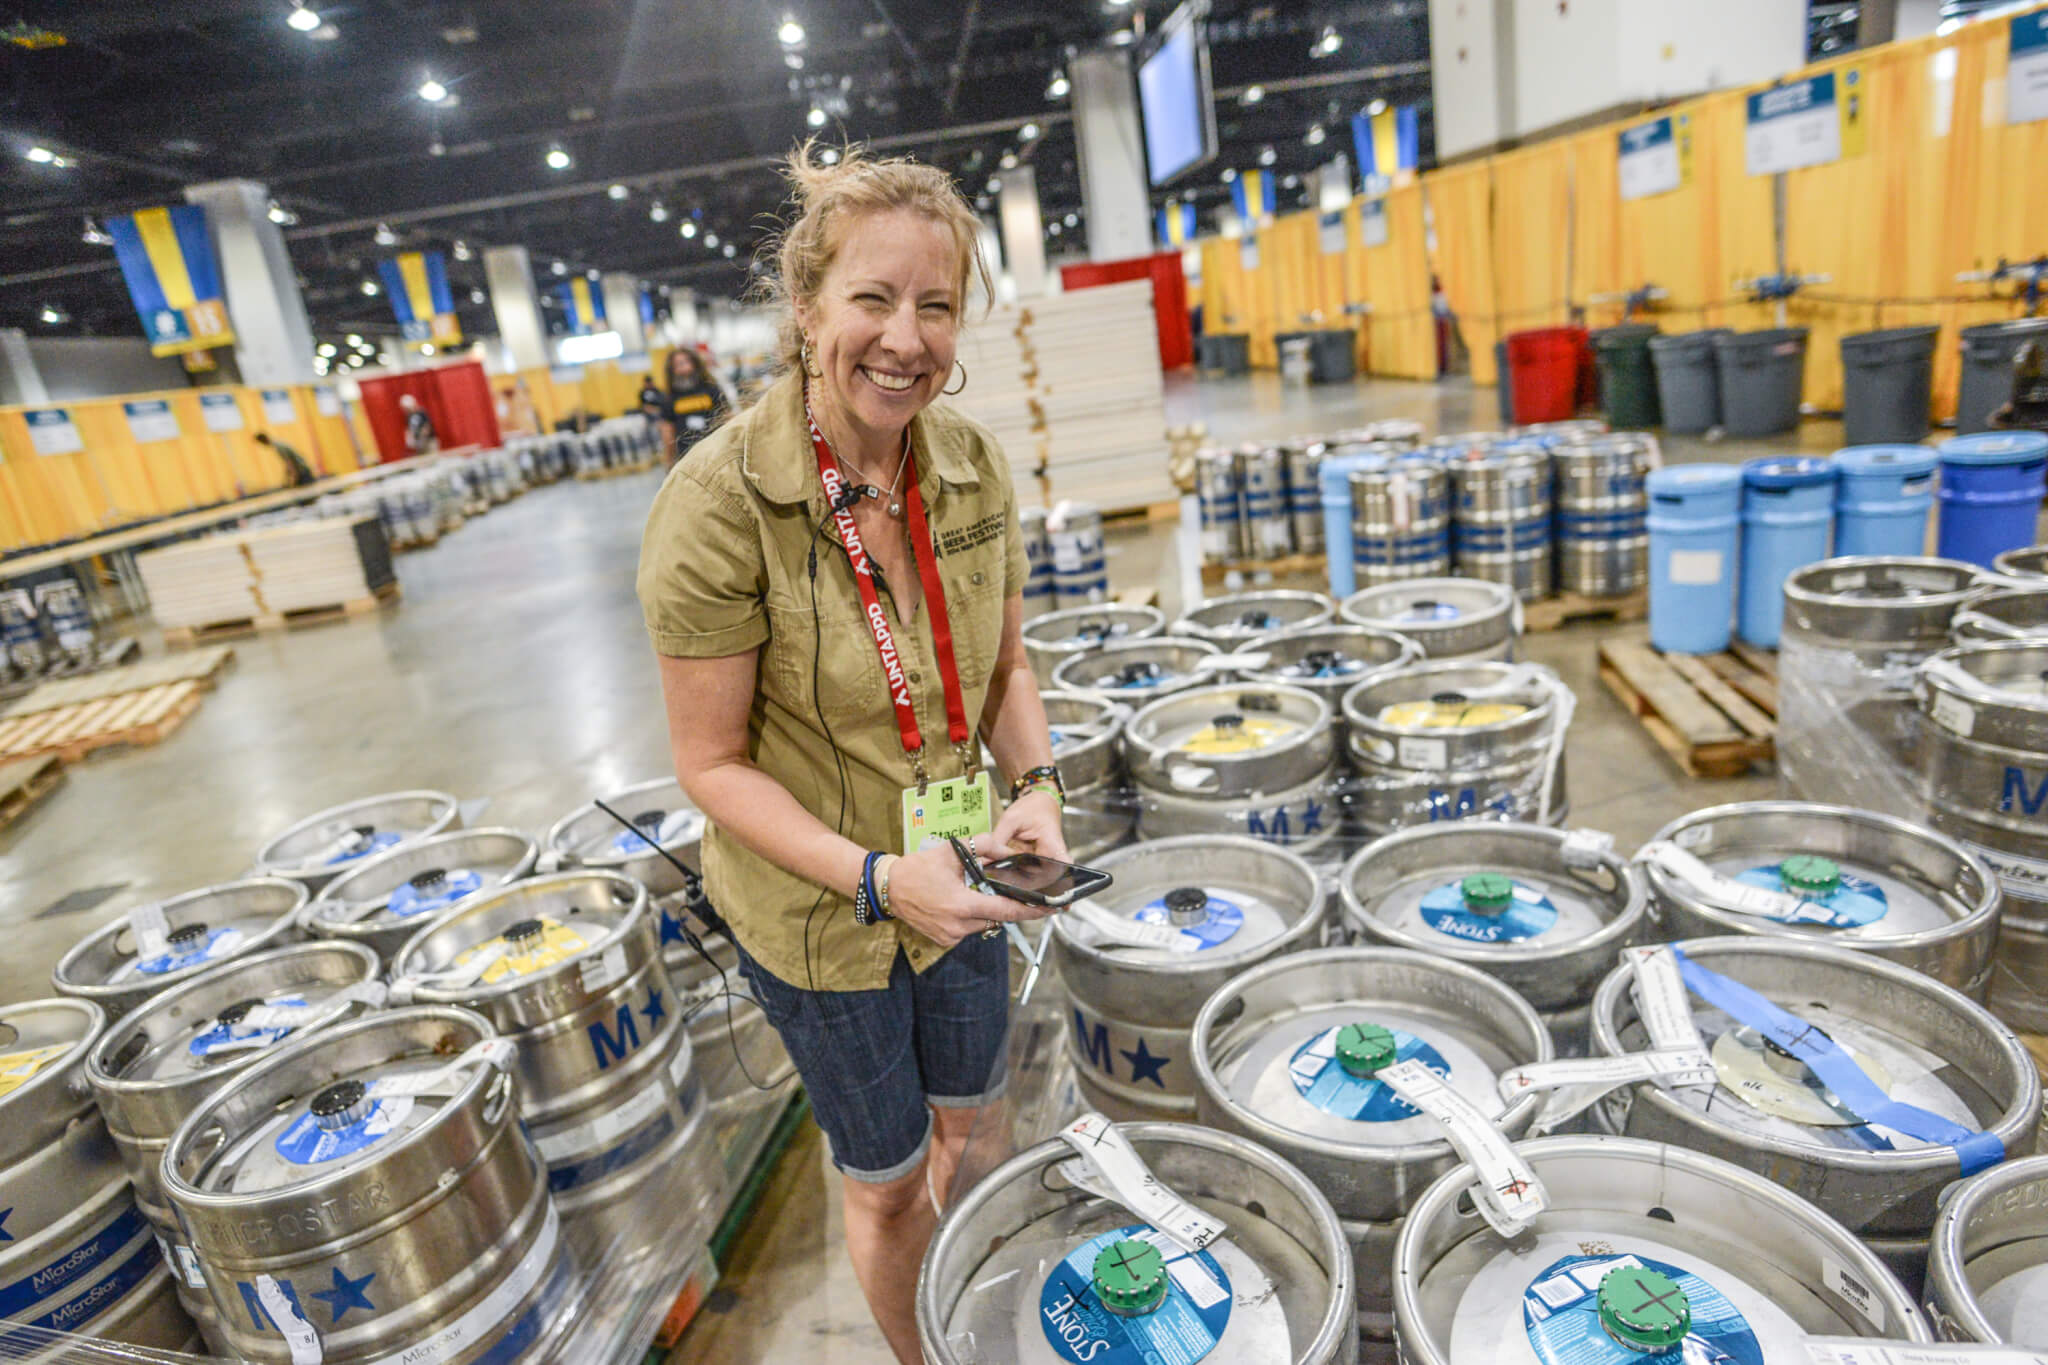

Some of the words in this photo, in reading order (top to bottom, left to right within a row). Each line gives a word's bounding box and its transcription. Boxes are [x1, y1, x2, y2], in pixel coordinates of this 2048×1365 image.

[941, 527, 963, 540] GREAT
[943, 535, 966, 549] BEER
[868, 603, 905, 690] UNTAPPD
[1248, 810, 1289, 846] M
[1435, 914, 1504, 942] STONE
[587, 1003, 640, 1070] M
[1073, 1007, 1115, 1076] M
[31, 1242, 100, 1290] MicroStar
[51, 1279, 117, 1327] MicroStar
[401, 1327, 464, 1365] Microtar
[1043, 1293, 1111, 1362] STONE
